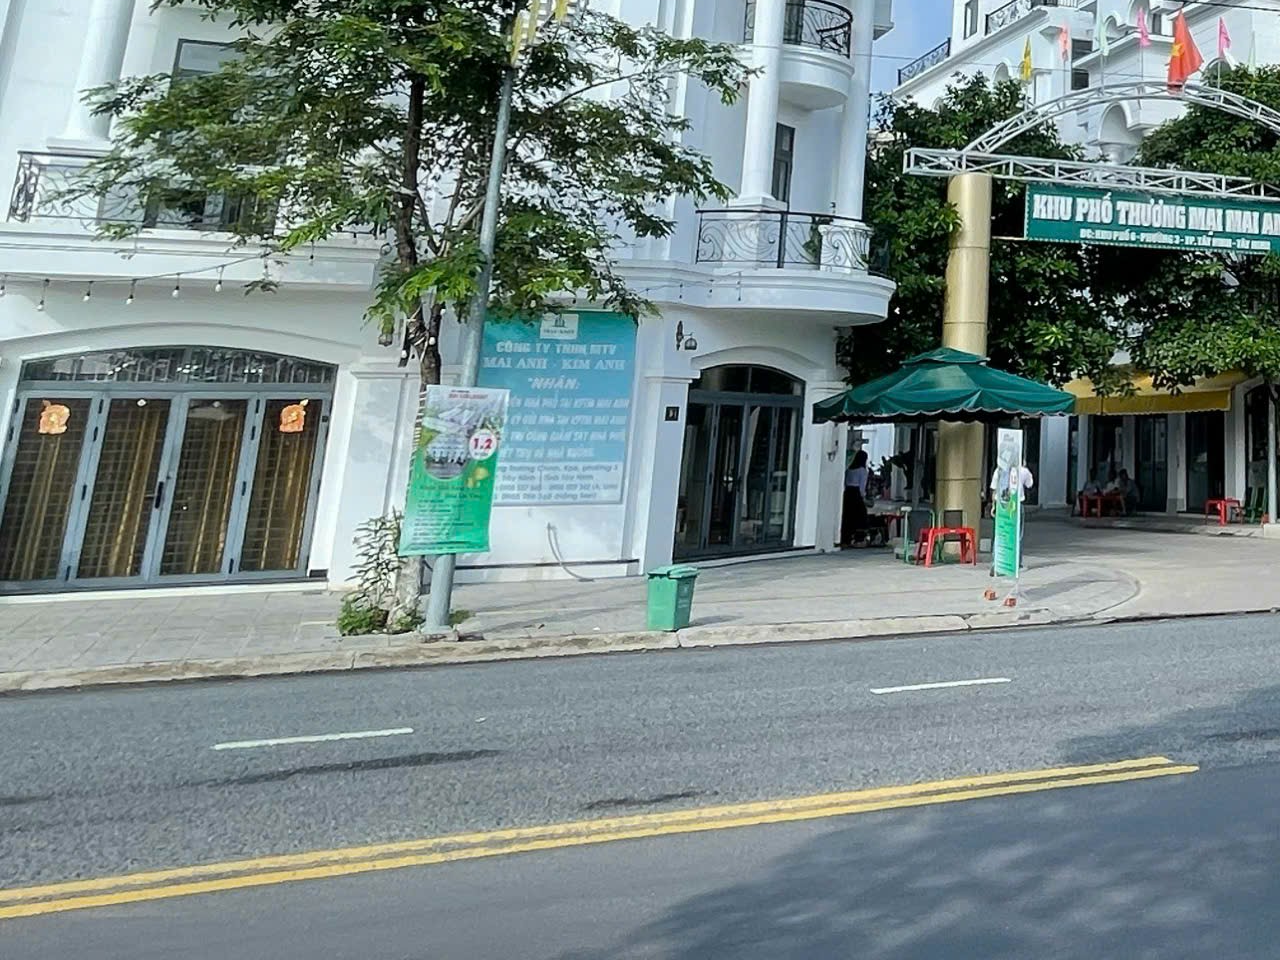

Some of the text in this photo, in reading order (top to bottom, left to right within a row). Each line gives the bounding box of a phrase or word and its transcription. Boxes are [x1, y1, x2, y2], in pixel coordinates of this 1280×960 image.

[1033, 194, 1073, 220] KHU
[1075, 192, 1113, 224] PHỐ
[1117, 198, 1186, 229] THƯƠNG
[496, 340, 531, 353] CÔNG
[536, 343, 550, 353] TY
[483, 357, 512, 368] MAI
[515, 358, 547, 369] ANH
[561, 359, 590, 370] KIM
[595, 360, 626, 370] ANH
[473, 438, 492, 450] 1.2
